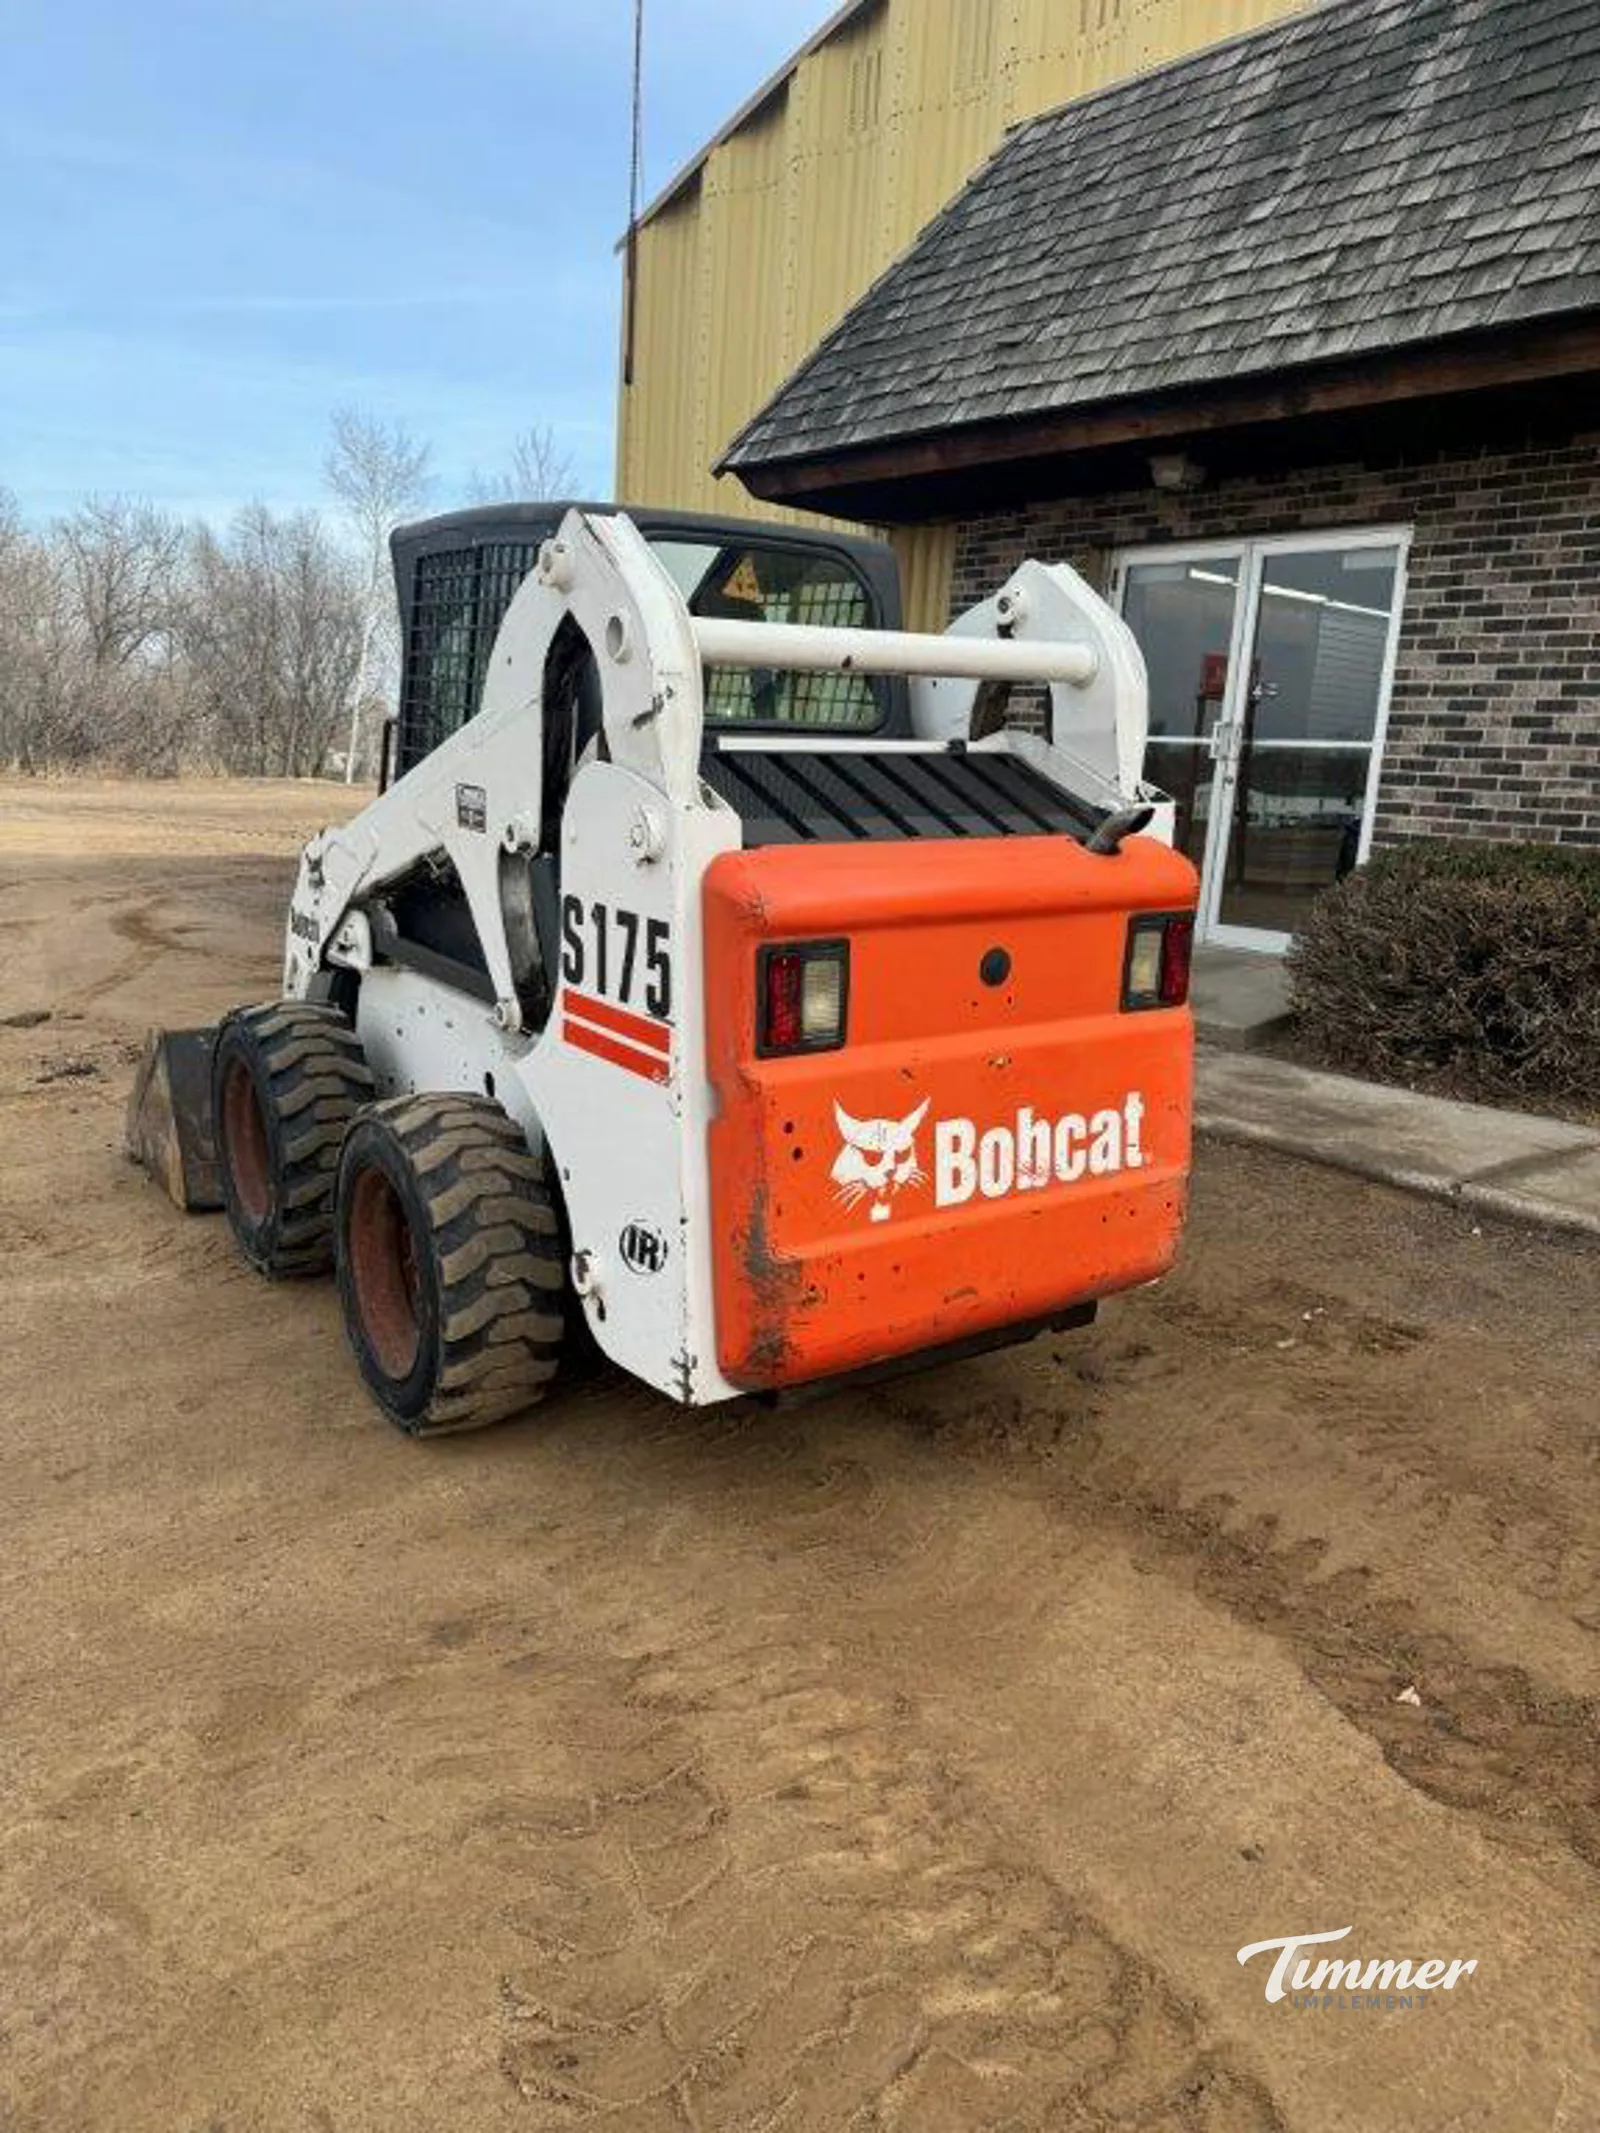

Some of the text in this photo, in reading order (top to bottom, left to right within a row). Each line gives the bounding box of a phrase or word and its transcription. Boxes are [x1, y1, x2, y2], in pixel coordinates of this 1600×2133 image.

[562, 894, 671, 1018] S175
[934, 1090, 1146, 1209] Bobcat
[625, 1225, 661, 1272] IR
